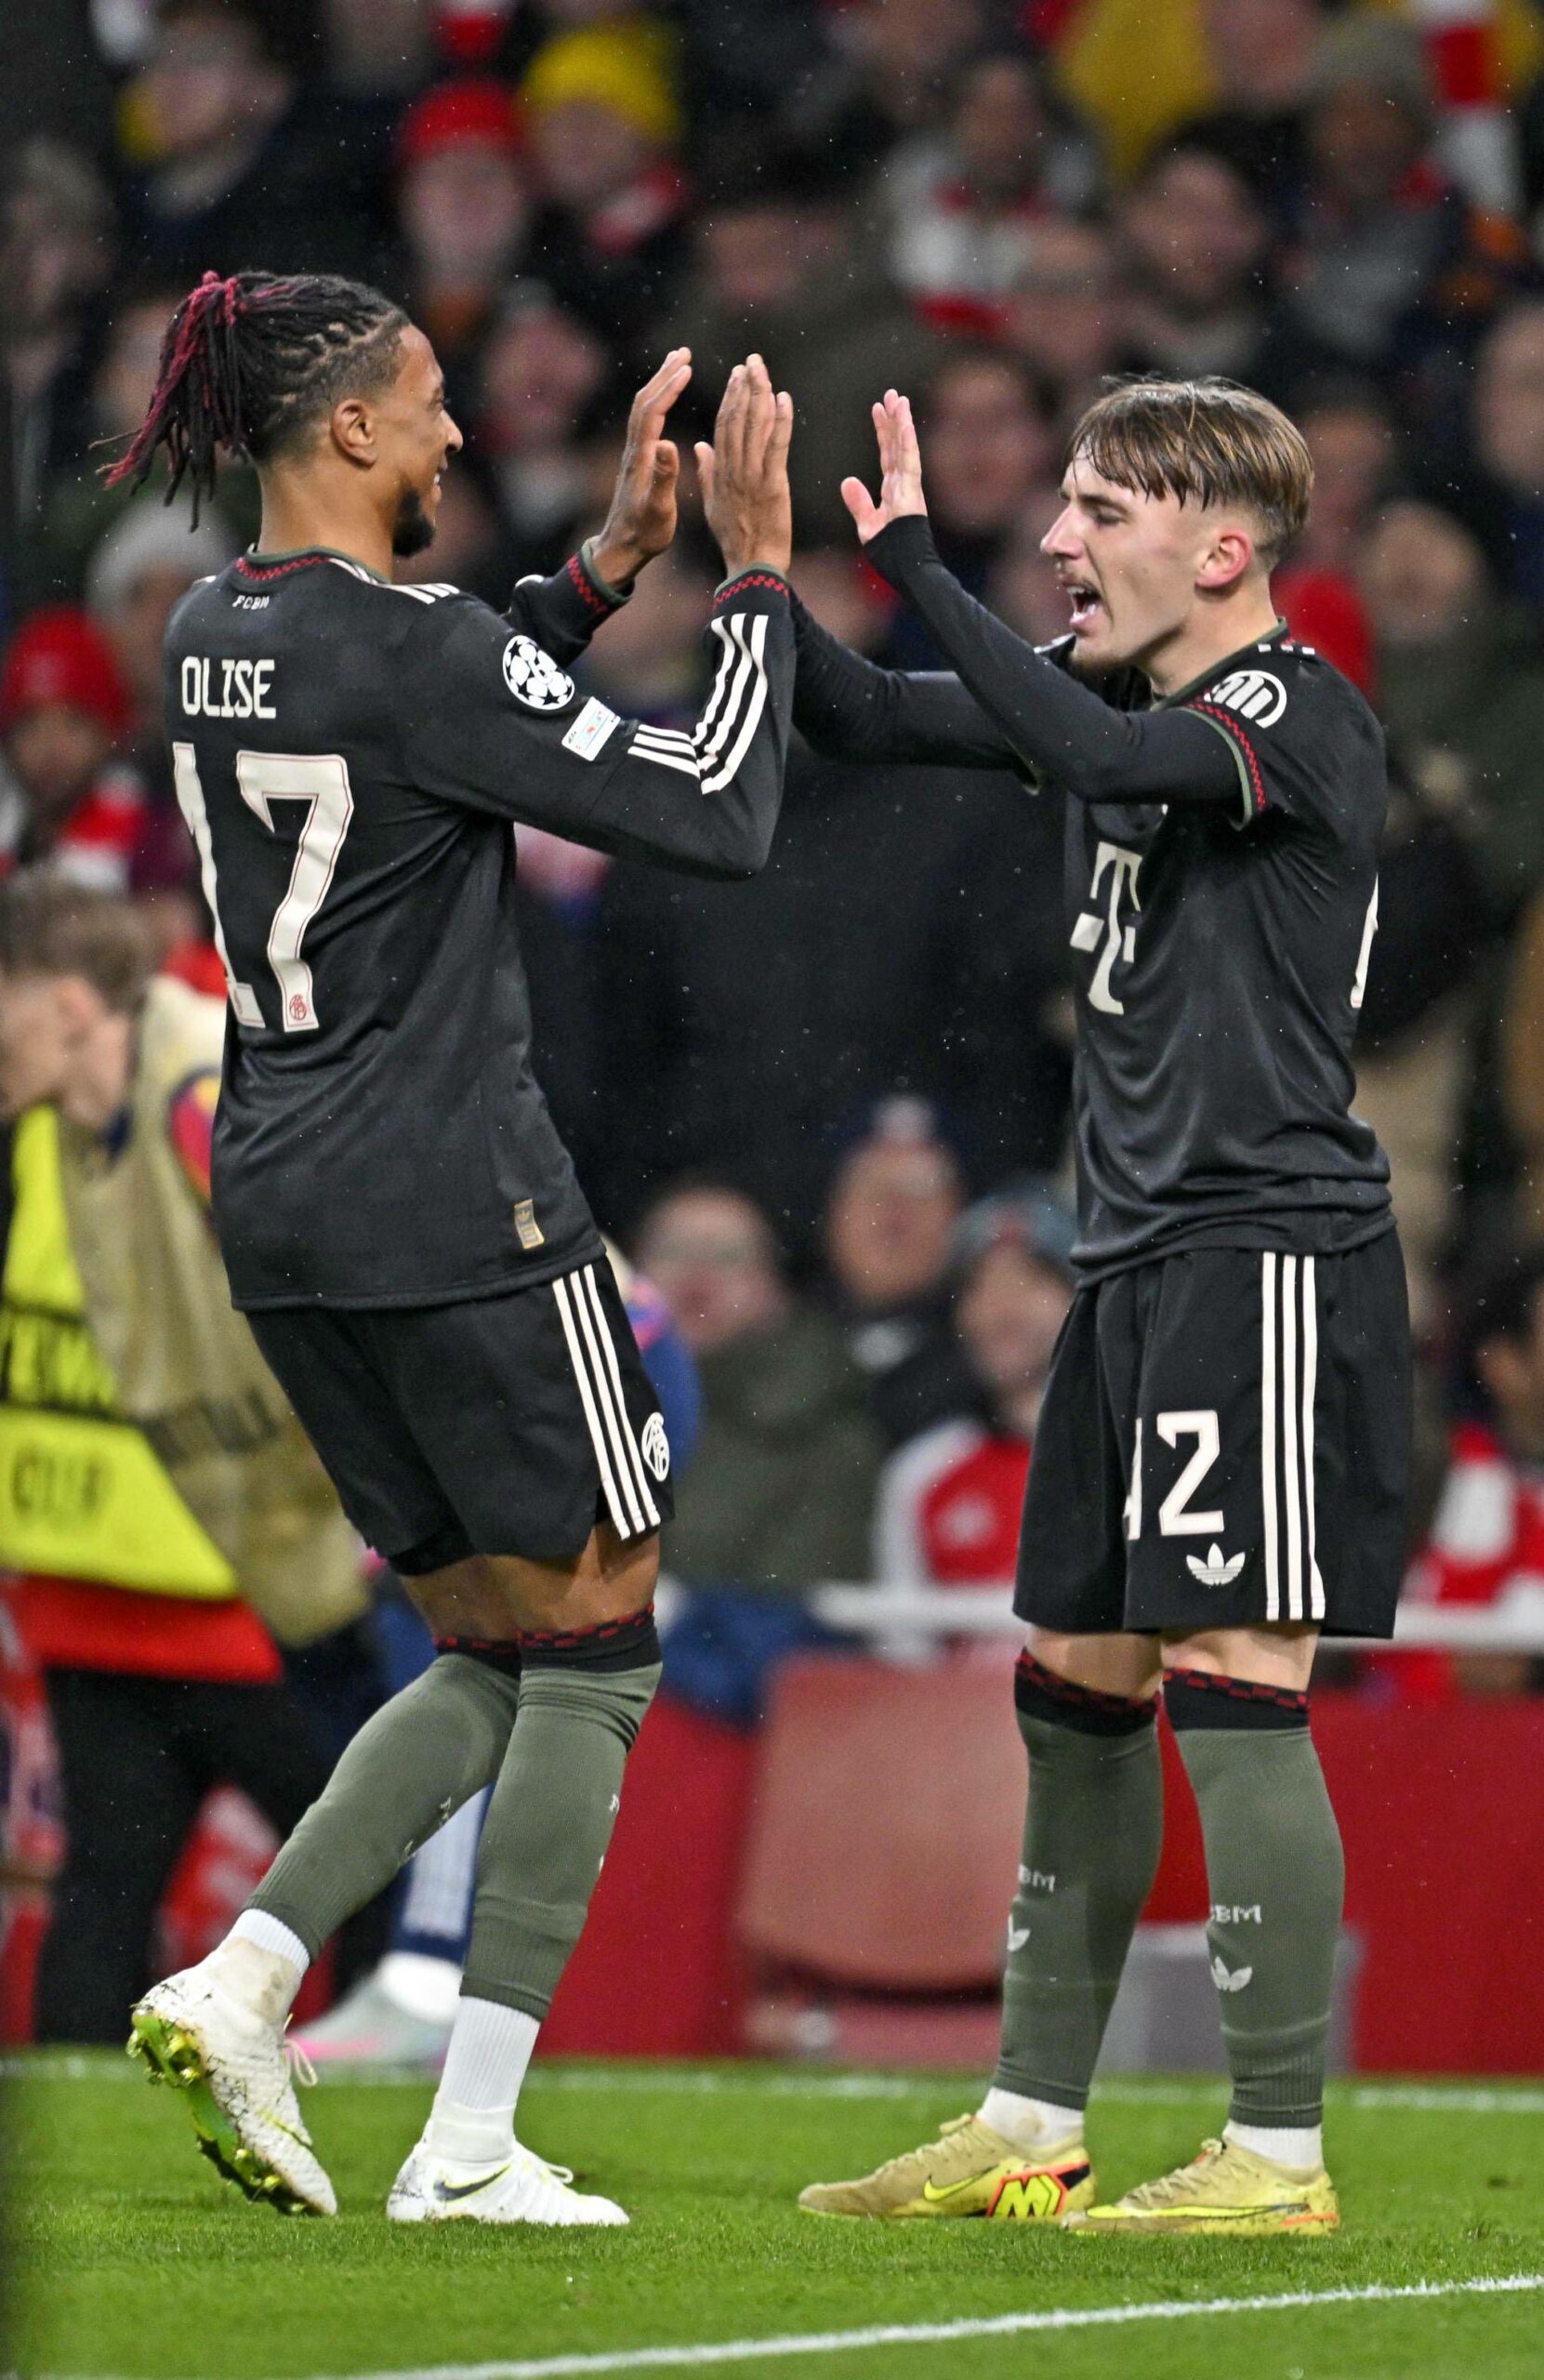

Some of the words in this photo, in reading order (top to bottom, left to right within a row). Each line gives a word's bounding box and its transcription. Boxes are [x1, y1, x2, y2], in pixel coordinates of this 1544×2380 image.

[181, 655, 277, 720] OLISE
[172, 741, 354, 1033] 17
[1209, 1904, 1262, 1925] BM
